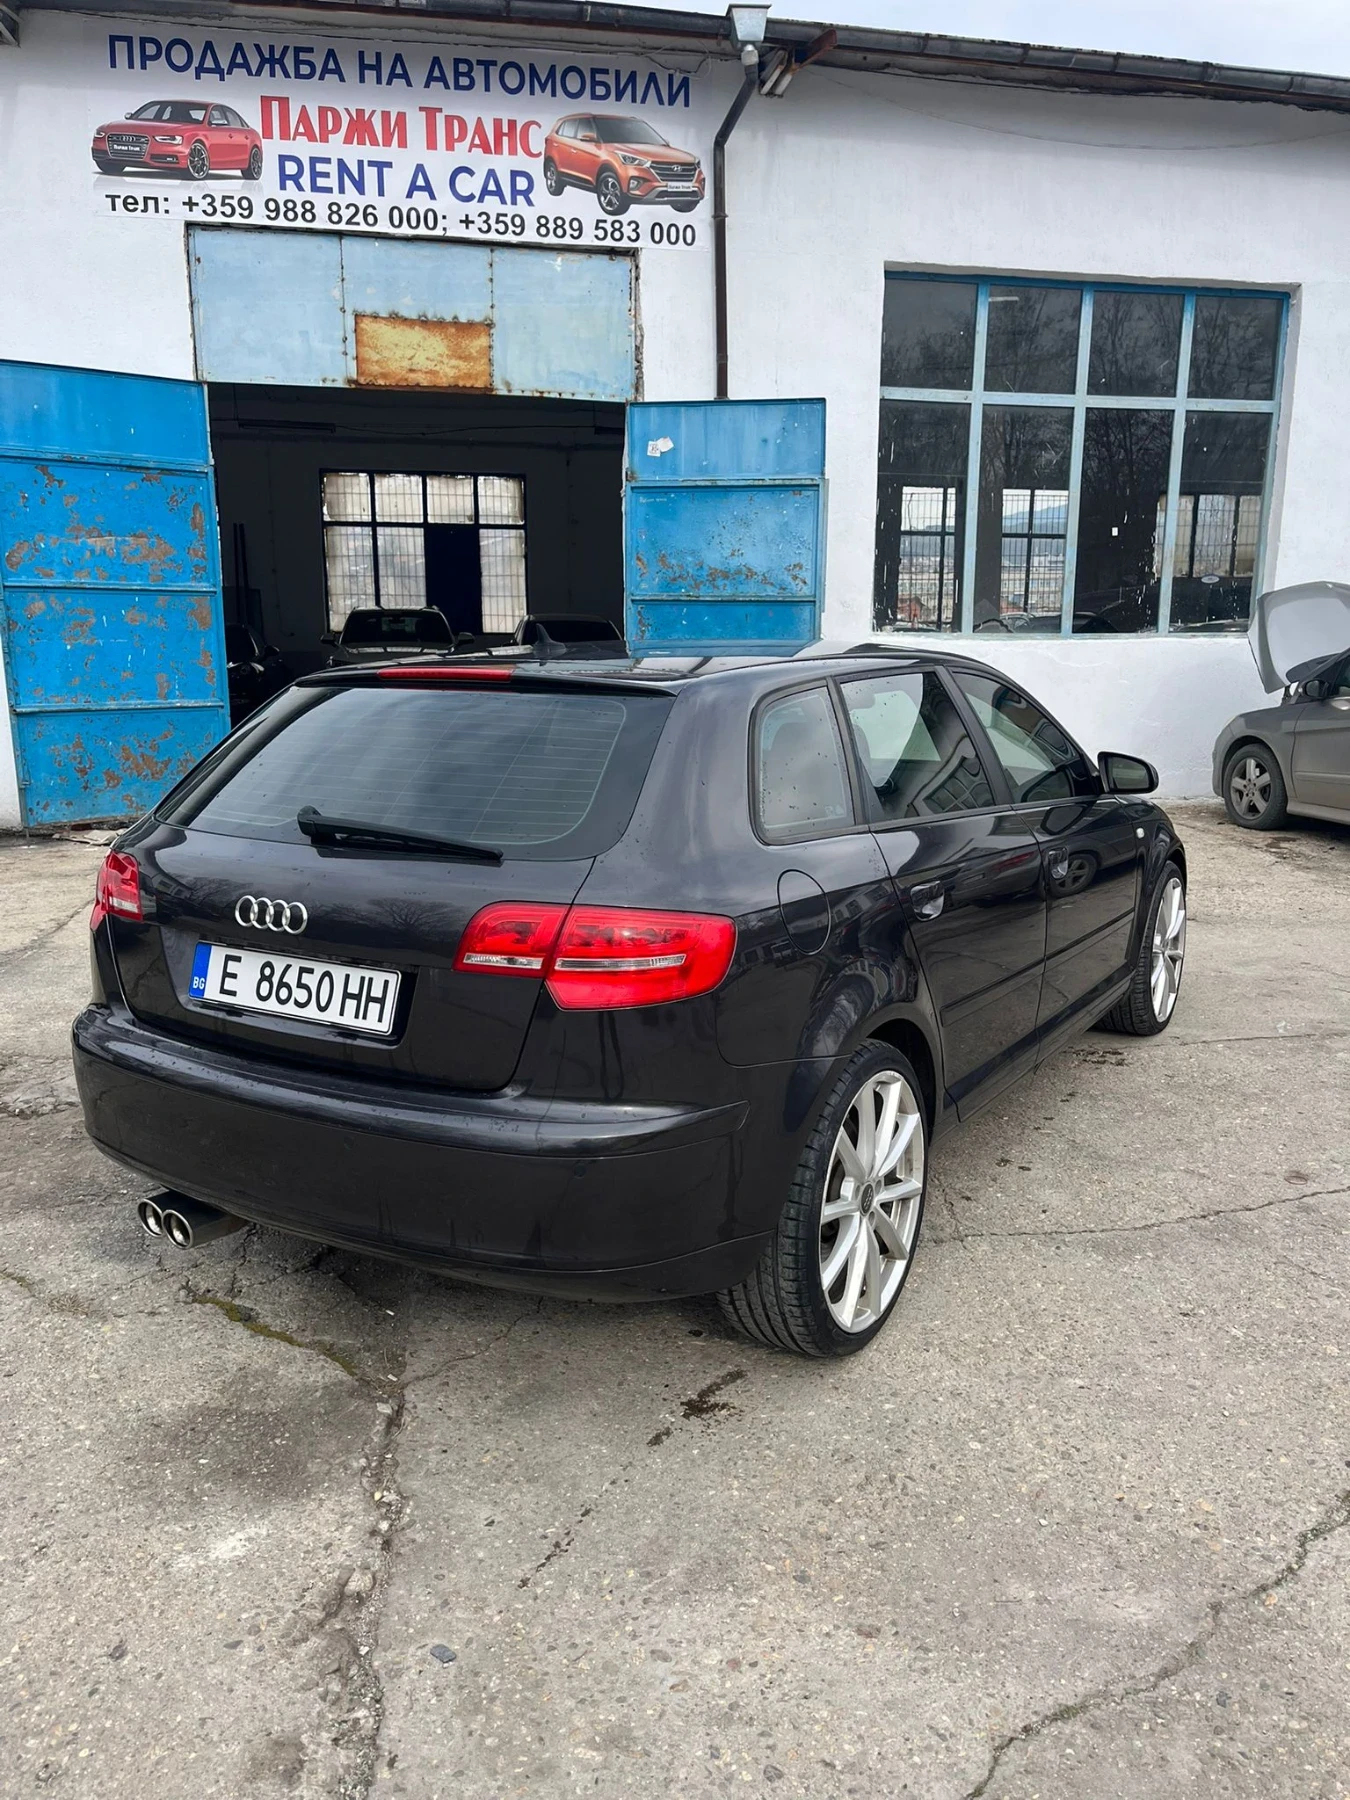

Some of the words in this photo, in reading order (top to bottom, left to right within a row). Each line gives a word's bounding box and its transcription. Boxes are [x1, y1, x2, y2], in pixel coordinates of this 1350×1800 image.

[109, 34, 346, 83] ПРОДАЖБА
[358, 50, 413, 88] НА
[423, 56, 691, 108] АВТОМОБИЛИ
[277, 154, 394, 198] RENT
[405, 163, 438, 202] A
[448, 165, 536, 208] CAR
[105, 194, 170, 215] тел:
[182, 193, 254, 220] +359
[264, 198, 317, 224] 988
[327, 202, 380, 228] 826
[388, 206, 448, 237] 000;
[459, 211, 526, 237] +359
[536, 215, 584, 241] 889
[594, 218, 641, 244] 583
[649, 221, 697, 247] 000
[192, 976, 206, 990] BG
[218, 953, 243, 997] E
